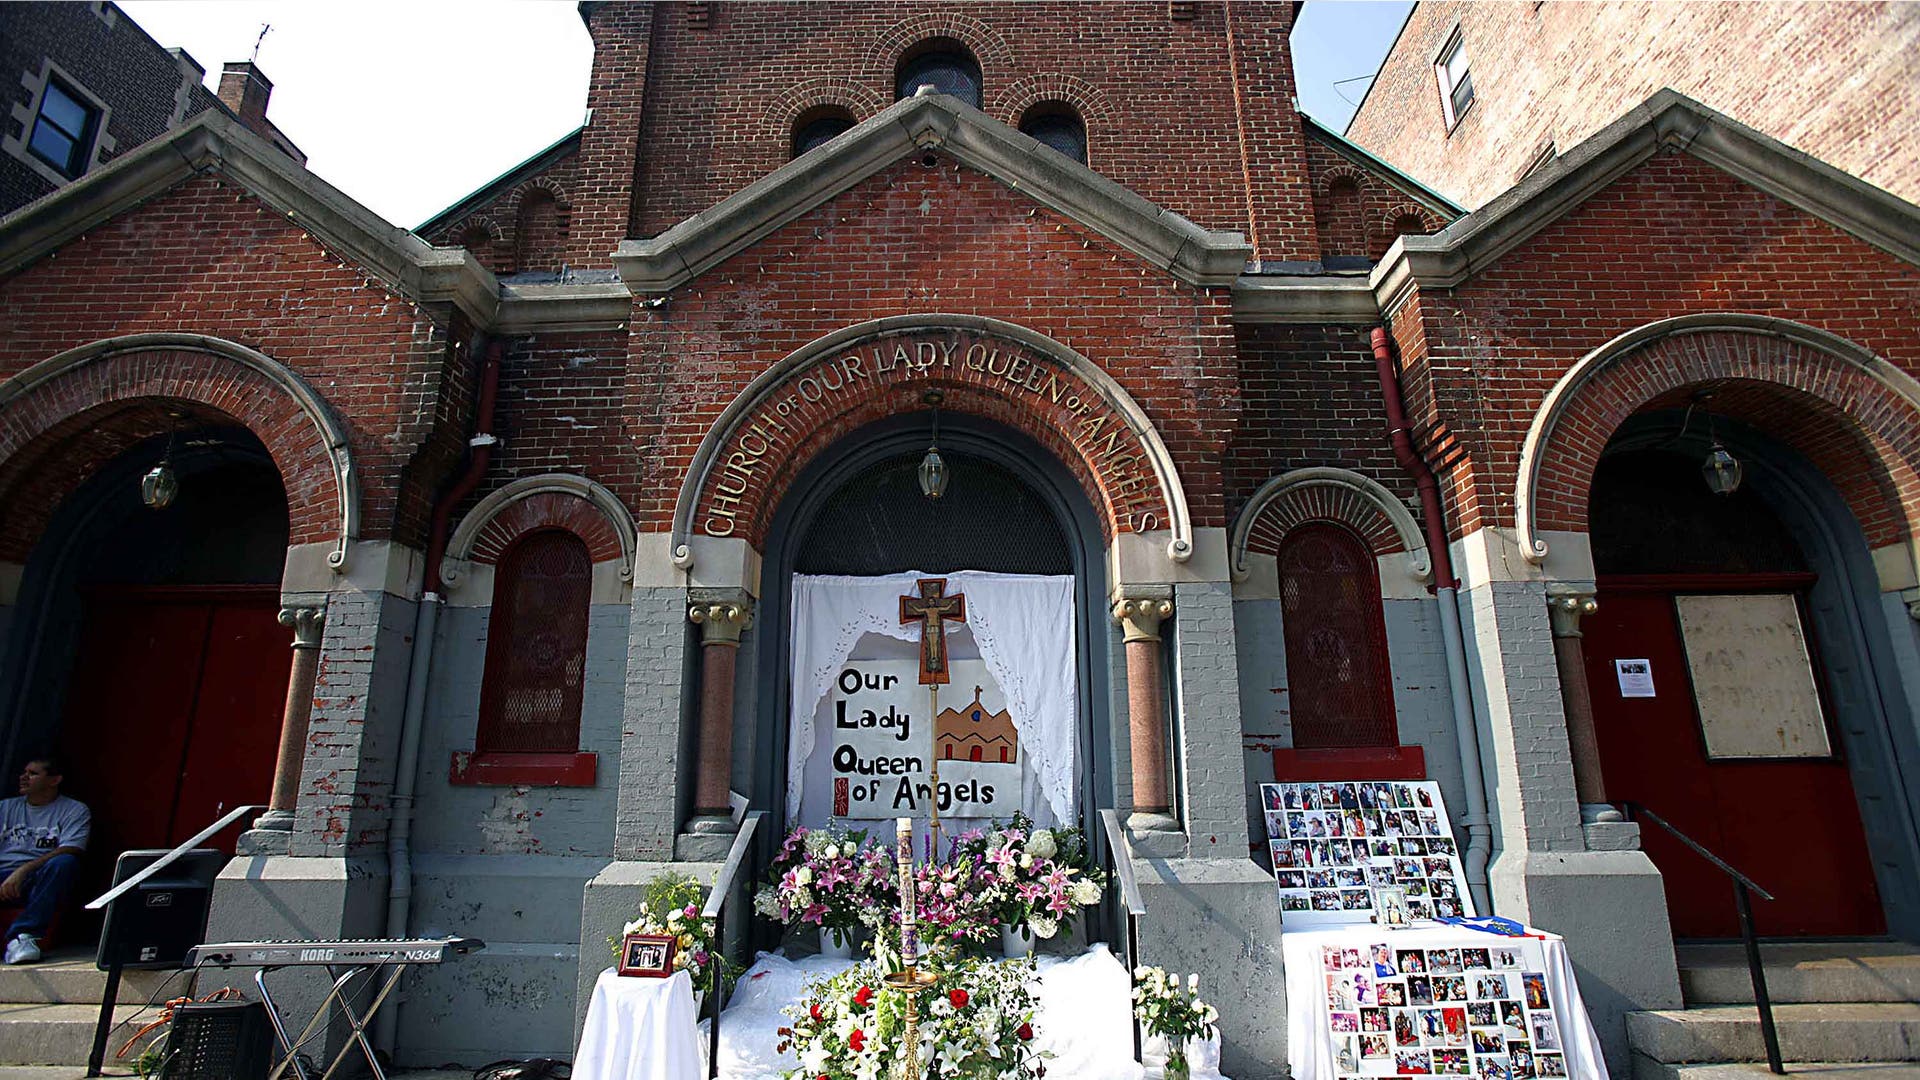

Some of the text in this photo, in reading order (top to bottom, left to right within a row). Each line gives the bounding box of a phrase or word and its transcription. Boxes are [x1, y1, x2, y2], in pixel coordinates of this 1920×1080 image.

[704, 341, 1158, 537] CHURCH OF OUR LADY QUEEN OF ANGELS
[838, 668, 899, 695] Our
[836, 700, 910, 741] Lady
[832, 744, 922, 776] Queen
[852, 776, 995, 811] of Angels
[300, 948, 335, 961] KORG
[404, 949, 440, 961] N364
